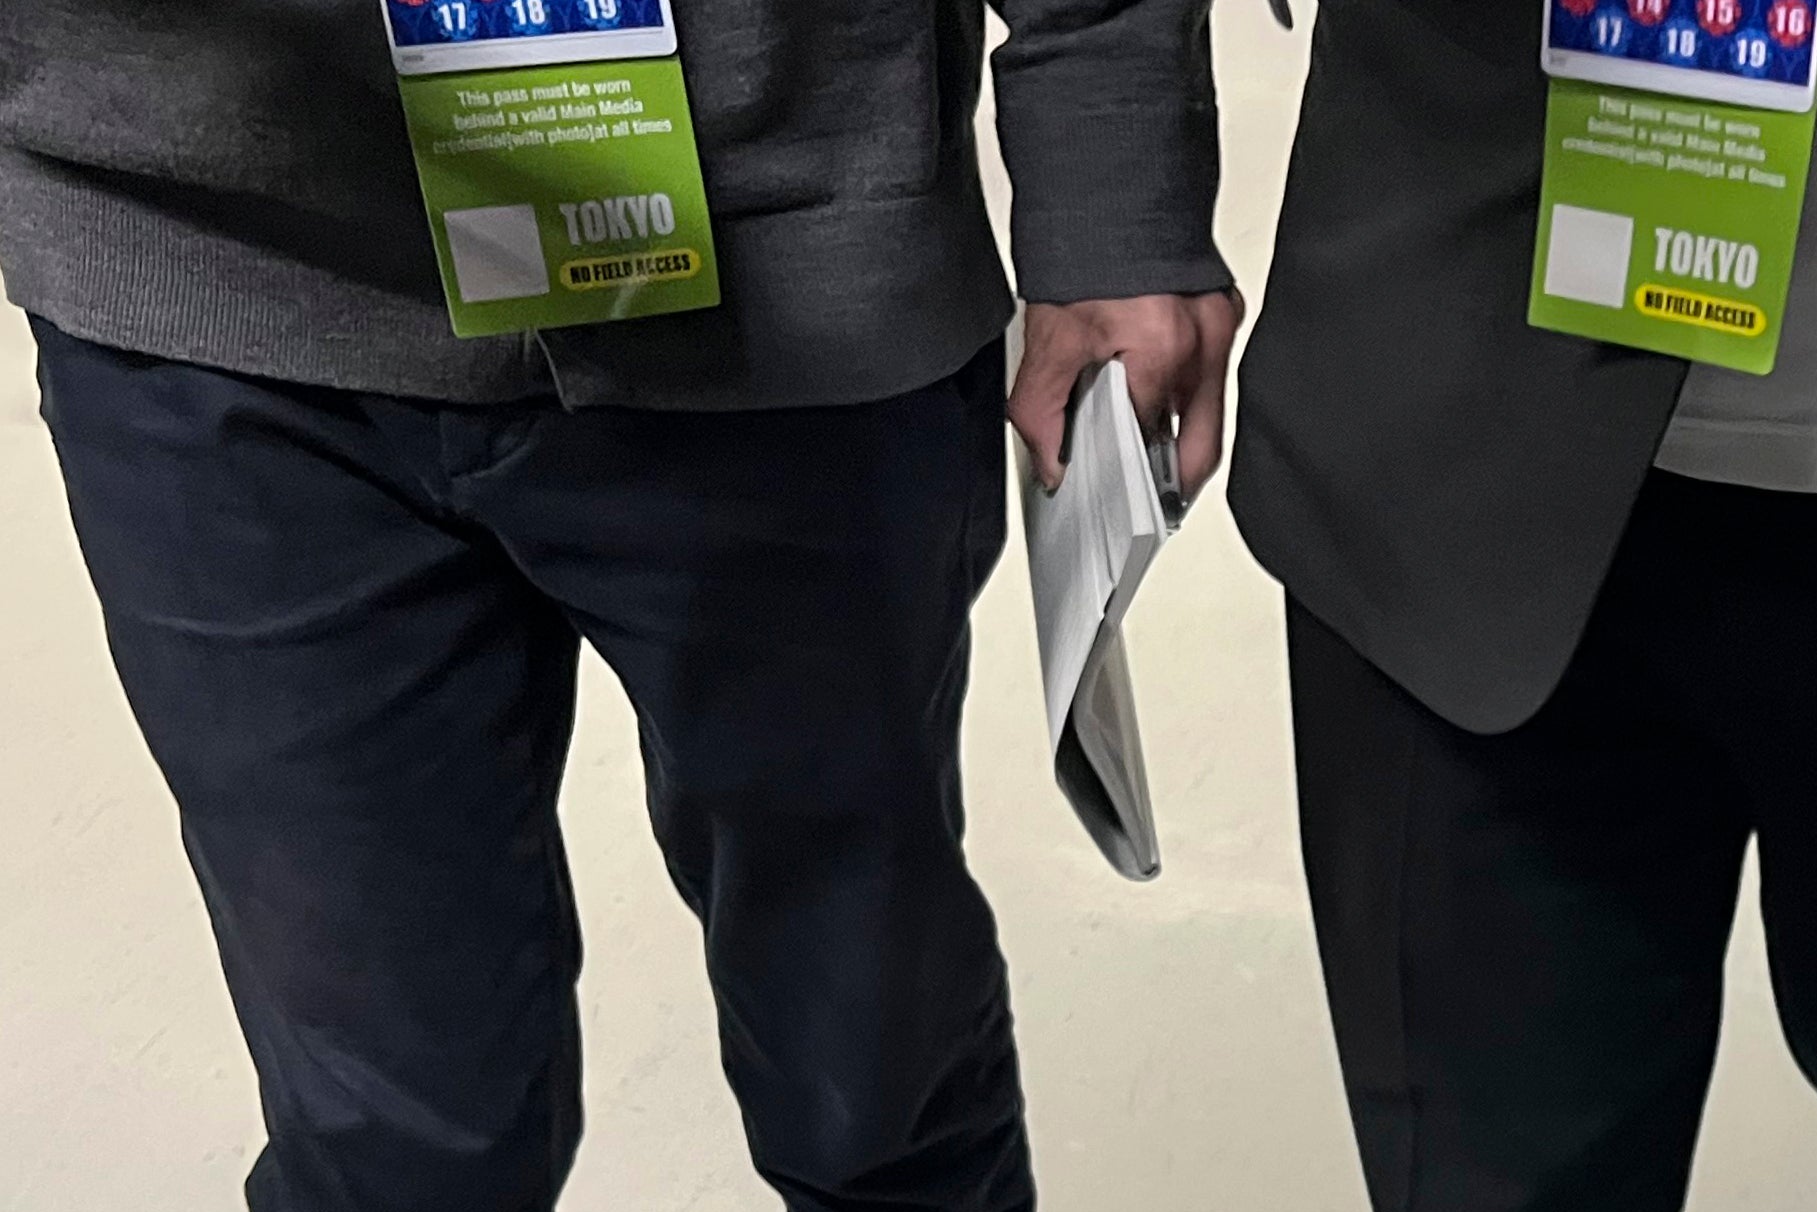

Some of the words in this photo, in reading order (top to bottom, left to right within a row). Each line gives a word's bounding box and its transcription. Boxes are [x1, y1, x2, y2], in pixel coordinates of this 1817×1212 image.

[438, 3, 466, 31] 17
[511, 0, 545, 26] 18
[1600, 16, 1622, 48] 17
[457, 90, 490, 107] This
[494, 88, 528, 106] pass
[532, 82, 569, 100] must
[572, 81, 590, 97] be
[593, 79, 631, 95] worn
[454, 110, 505, 130] behind
[521, 105, 557, 124] valid
[560, 102, 596, 120] Main
[599, 98, 643, 116] Media
[612, 121, 630, 136] all
[632, 118, 672, 135] times
[559, 193, 675, 246] TOKYO
[570, 265, 591, 284] NO
[593, 260, 633, 281] FIELD
[636, 254, 690, 276] ACCESS
[1655, 227, 1758, 289] TOKYO
[1645, 291, 1664, 309] NO
